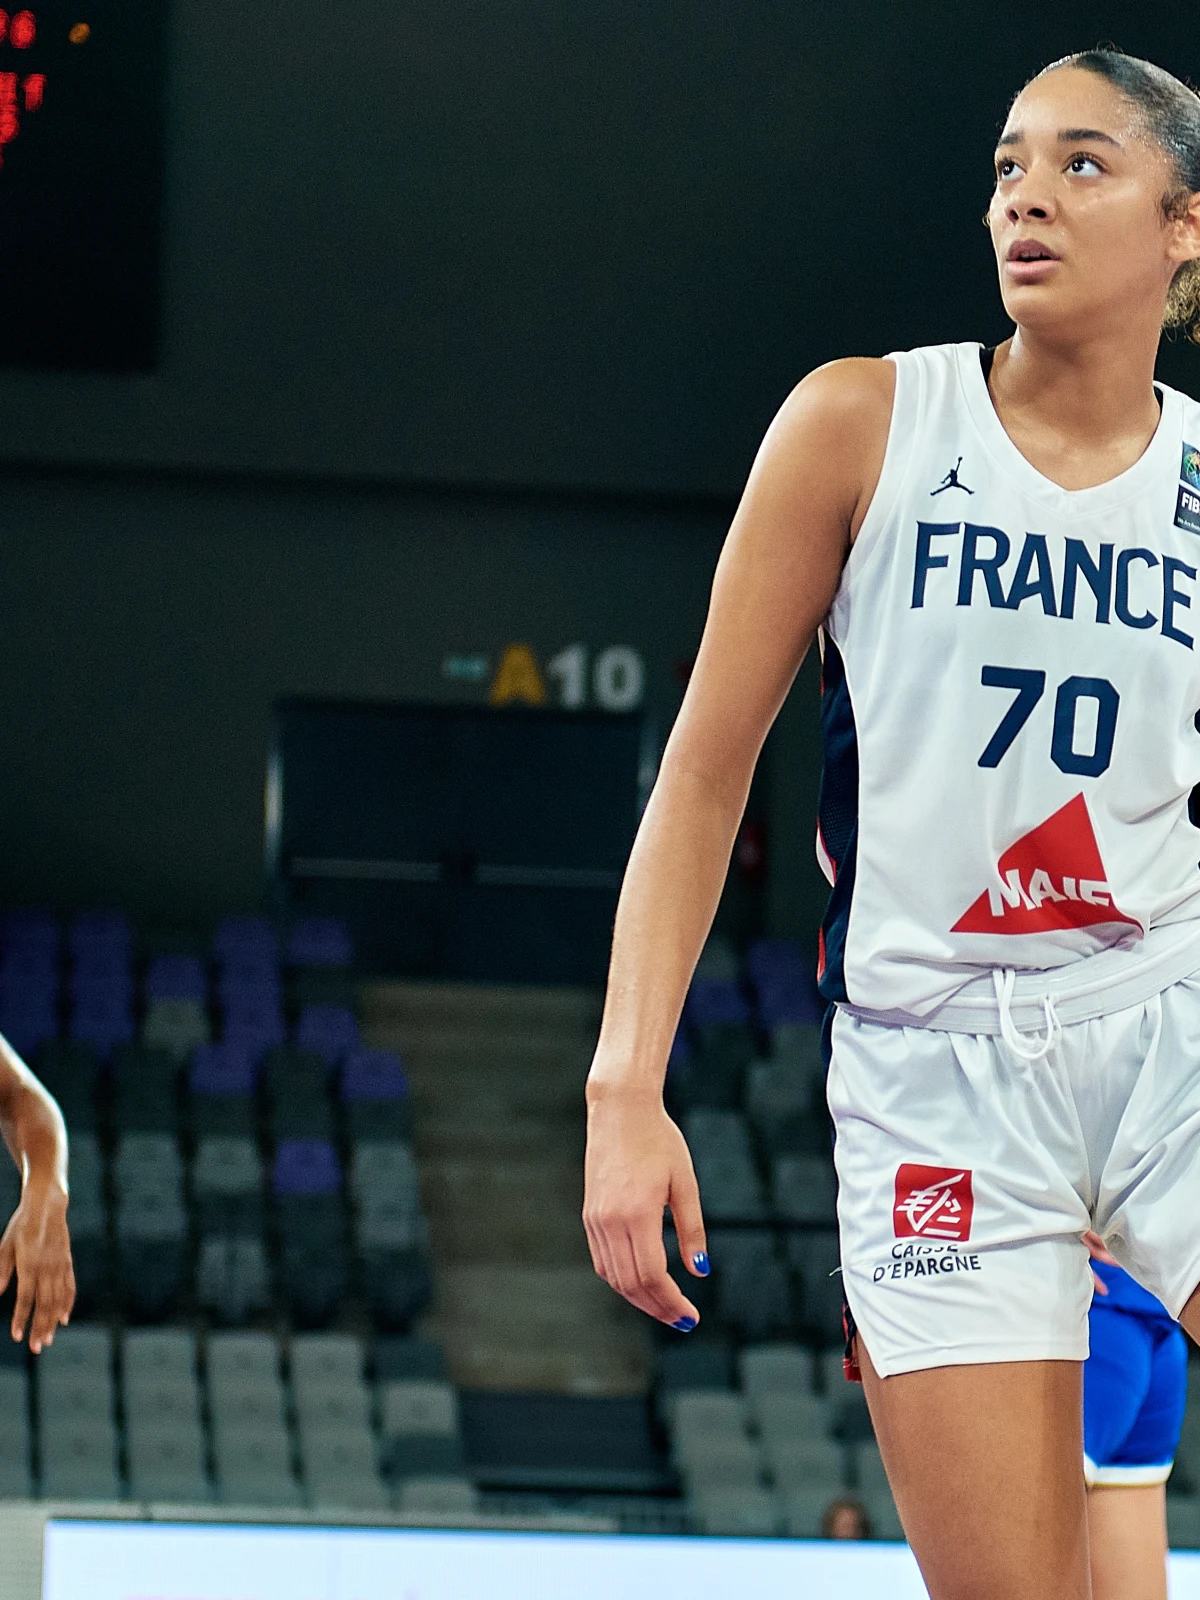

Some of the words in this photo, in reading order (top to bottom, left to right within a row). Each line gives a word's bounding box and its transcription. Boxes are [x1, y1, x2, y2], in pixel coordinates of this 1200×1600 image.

[910, 520, 1198, 651] FRANCE
[489, 642, 645, 712] A10
[977, 665, 1121, 778] 70
[873, 1255, 982, 1283] D'EPARGNE
